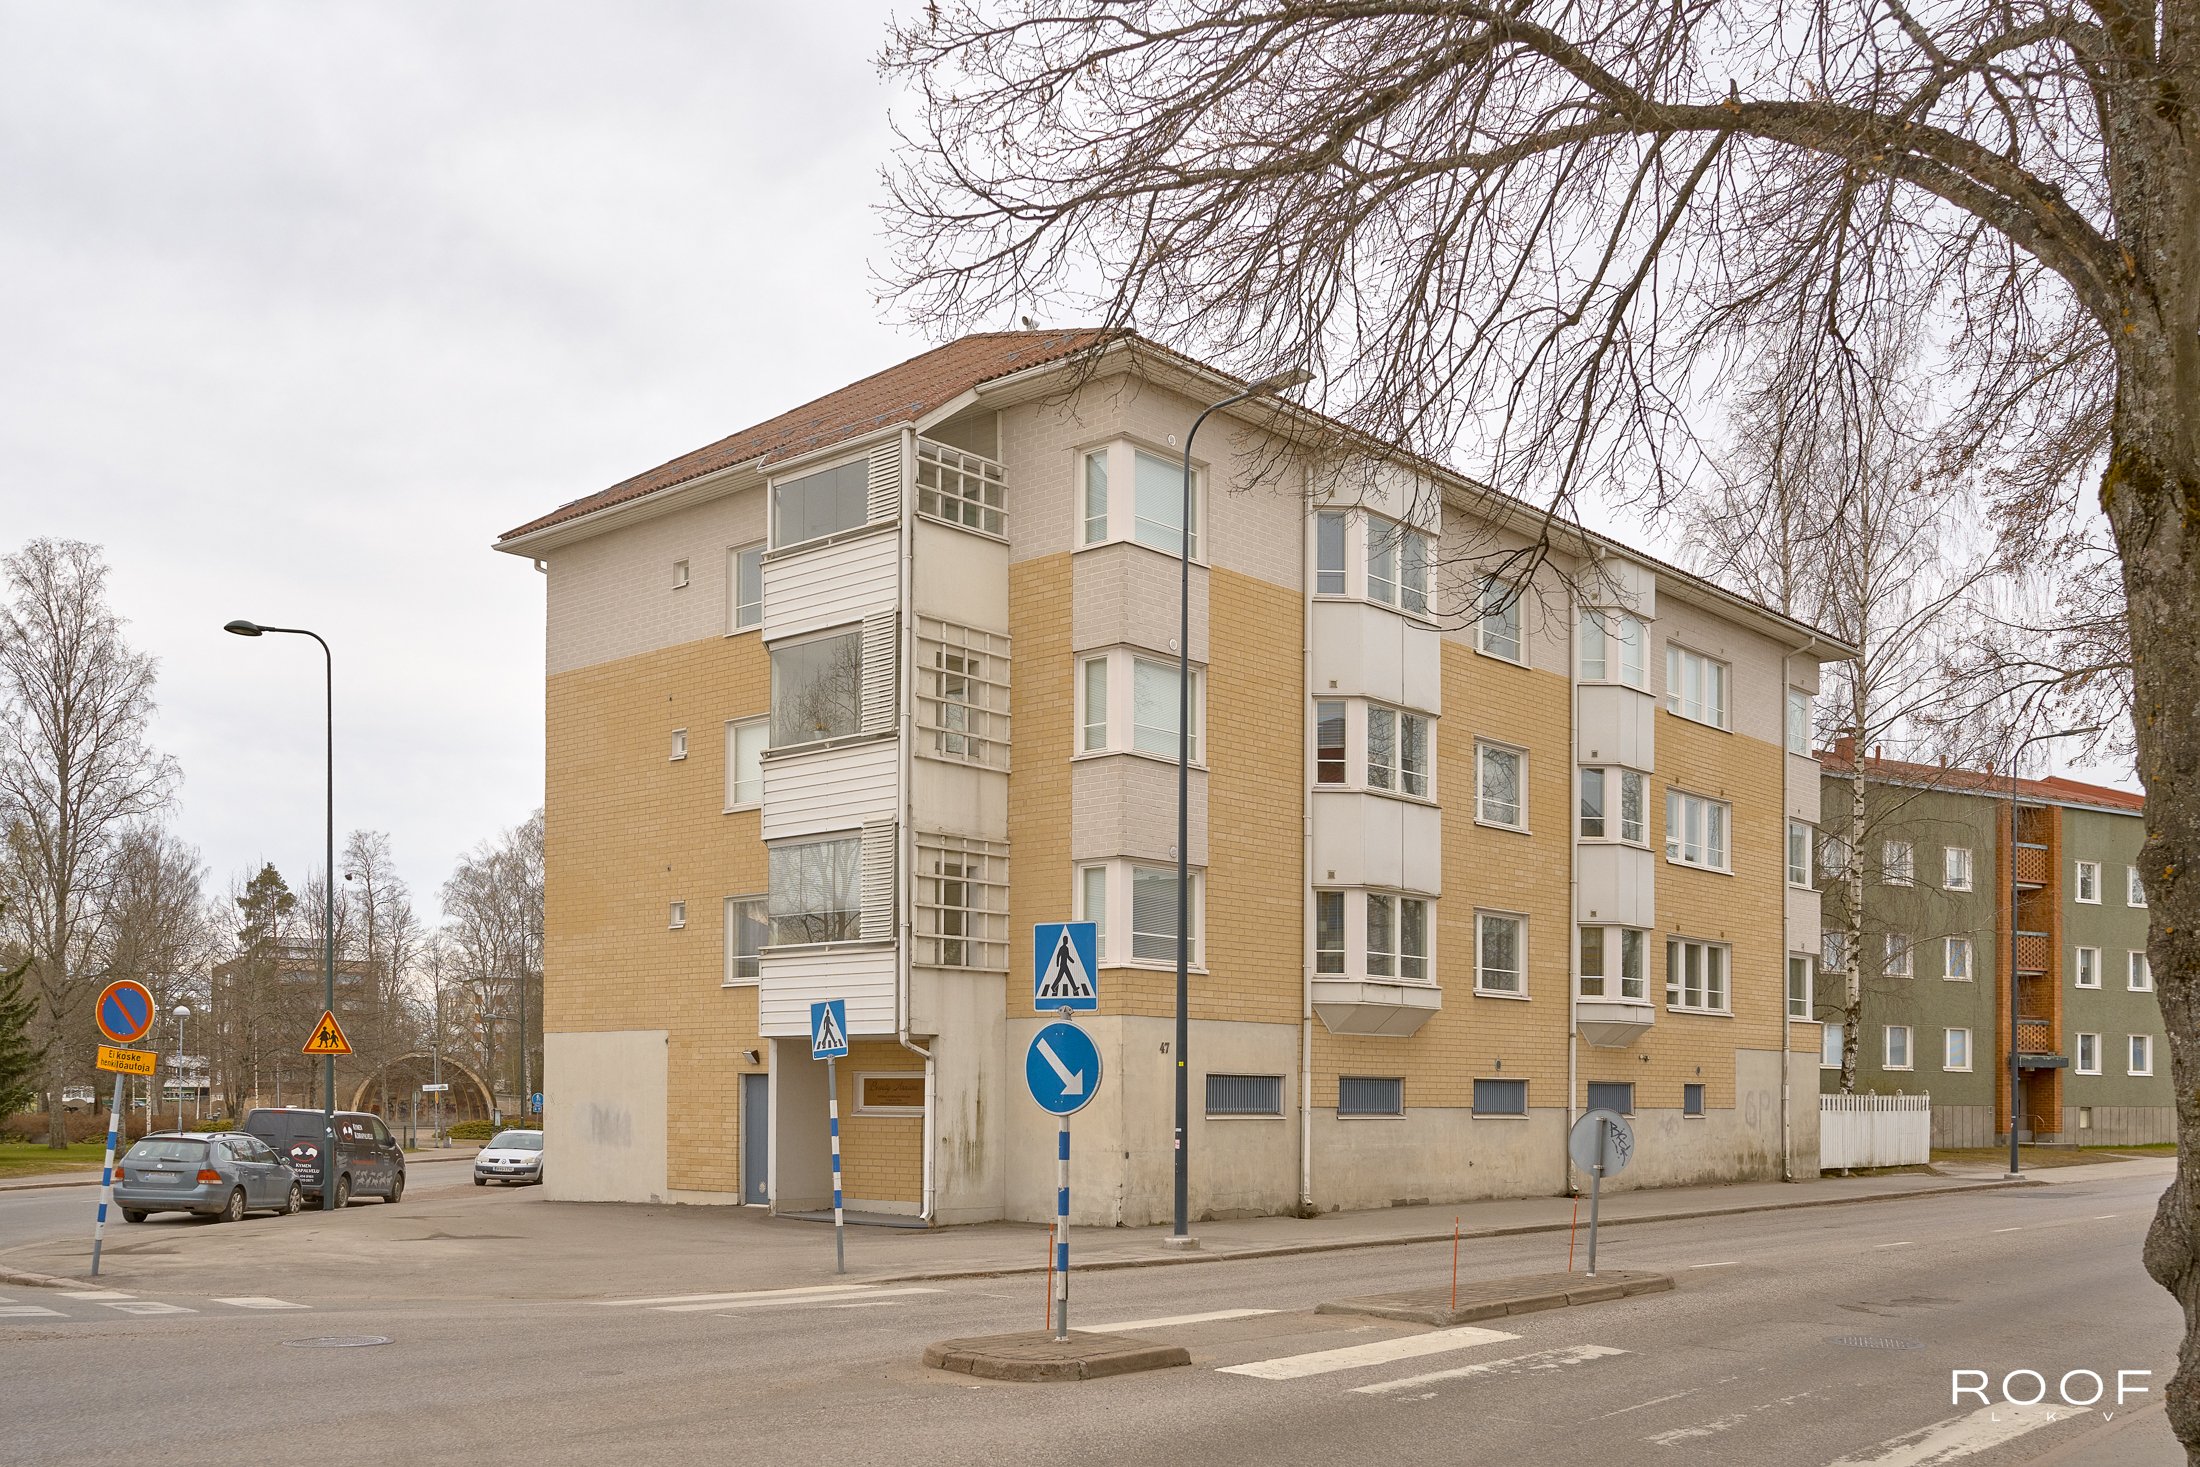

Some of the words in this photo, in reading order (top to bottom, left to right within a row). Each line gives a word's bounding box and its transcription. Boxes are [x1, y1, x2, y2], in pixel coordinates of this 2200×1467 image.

[1159, 1042, 1170, 1054] 47
[109, 1050, 114, 1058] Ei
[116, 1051, 141, 1061] koske
[101, 1059, 150, 1072] henkilöautoja
